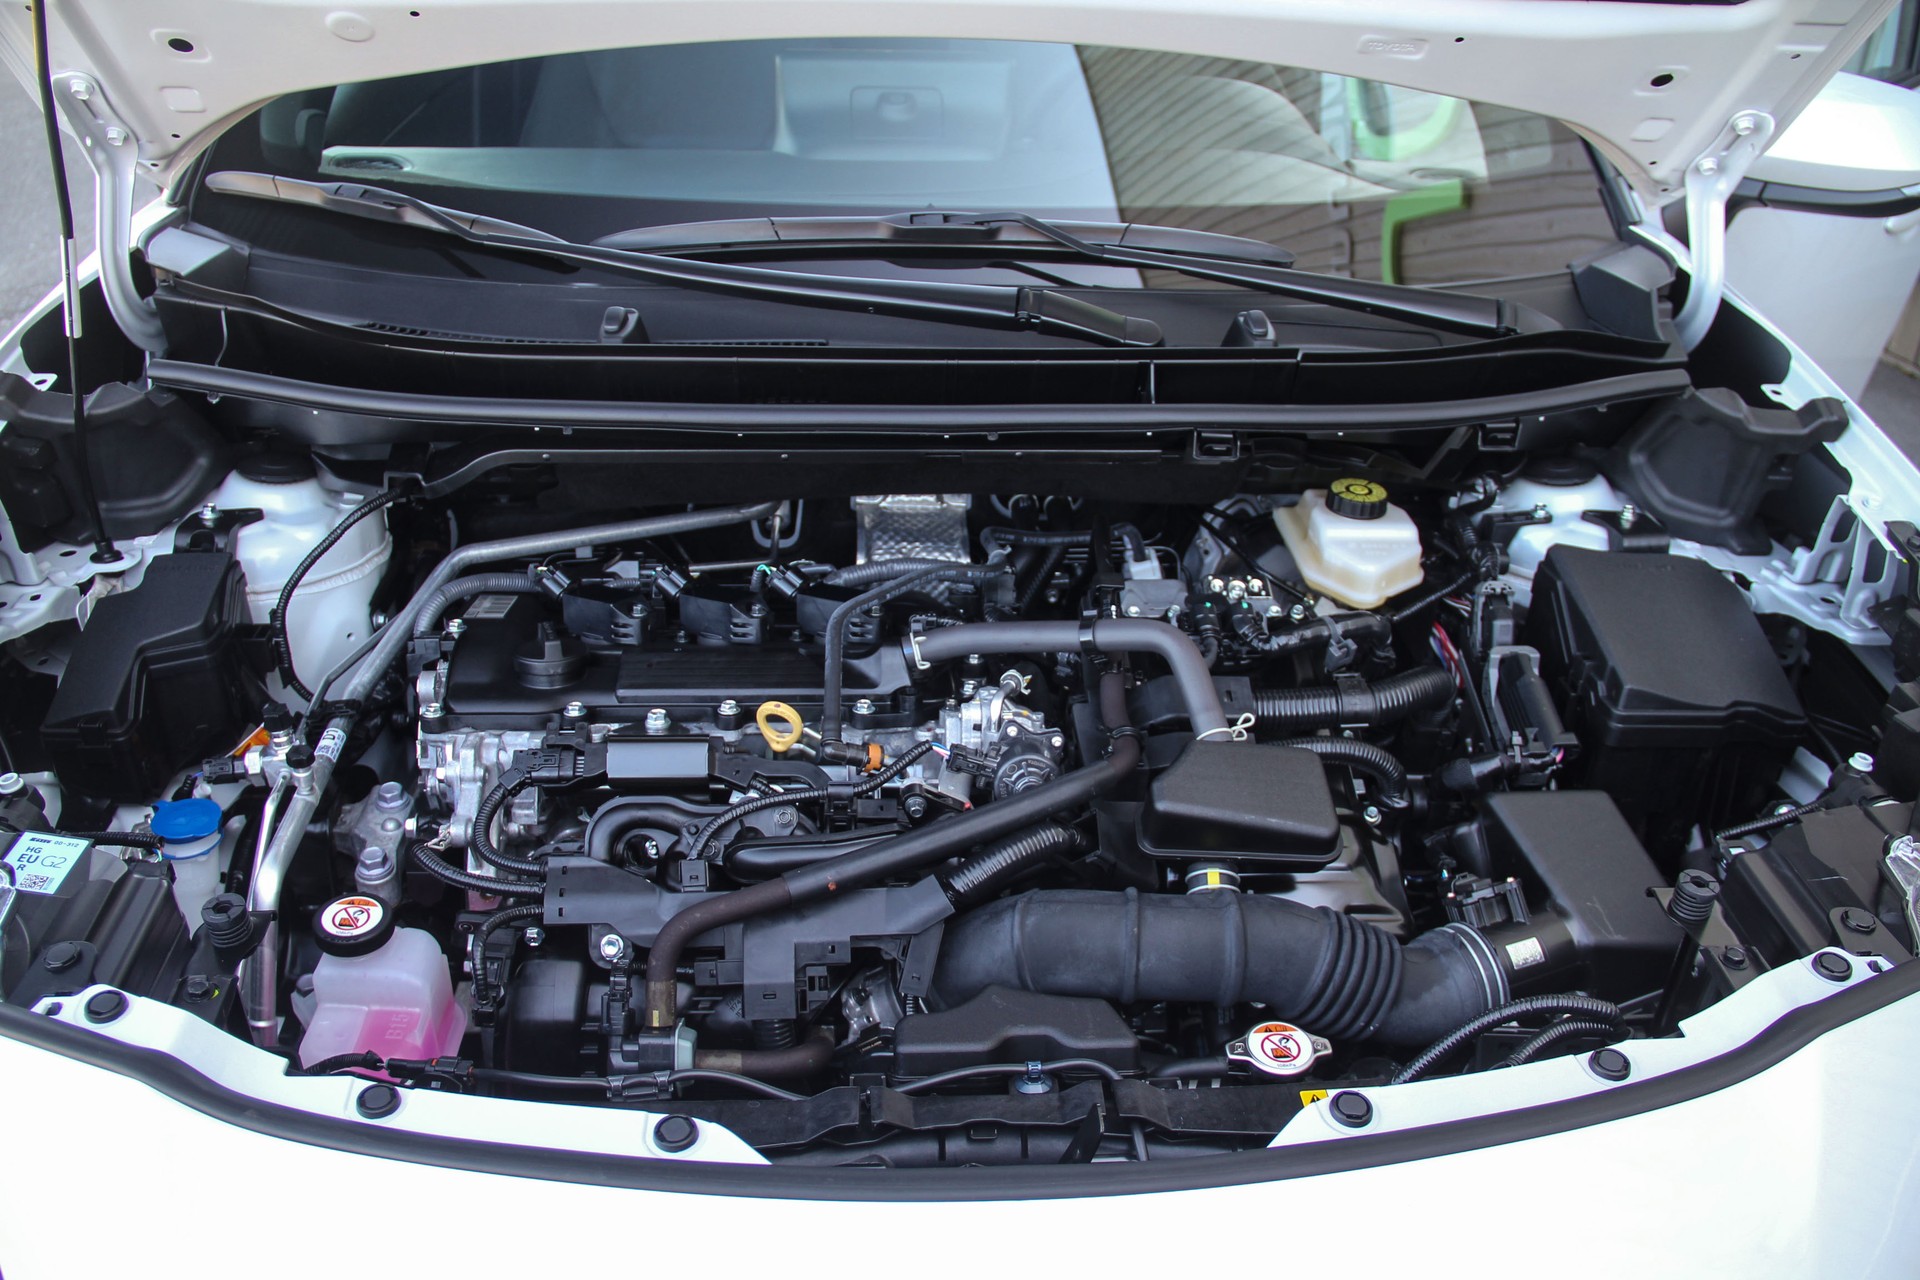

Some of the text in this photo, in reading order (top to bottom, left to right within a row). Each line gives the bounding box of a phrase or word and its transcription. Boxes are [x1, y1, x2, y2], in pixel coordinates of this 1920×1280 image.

[1367, 42, 1416, 52] TOYOTA
[25, 846, 43, 854] HG
[17, 853, 40, 864] EU
[41, 855, 67, 869] G2
[16, 863, 27, 871] R
